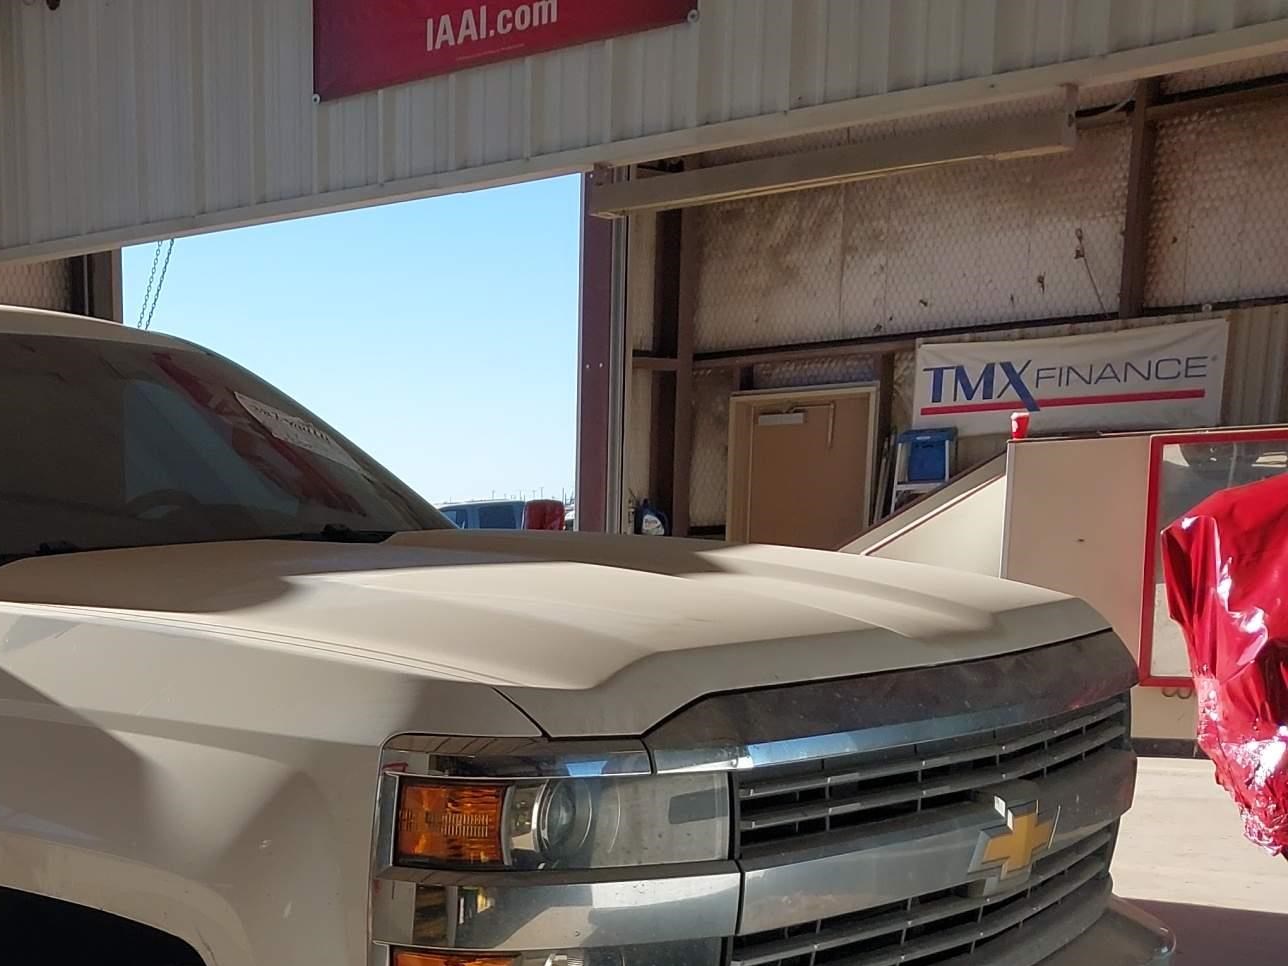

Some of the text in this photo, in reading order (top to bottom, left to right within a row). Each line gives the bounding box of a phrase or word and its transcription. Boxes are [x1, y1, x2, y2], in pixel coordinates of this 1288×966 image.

[426, 0, 558, 51] IAAI.com
[923, 356, 1209, 411] TMX FINANCE
